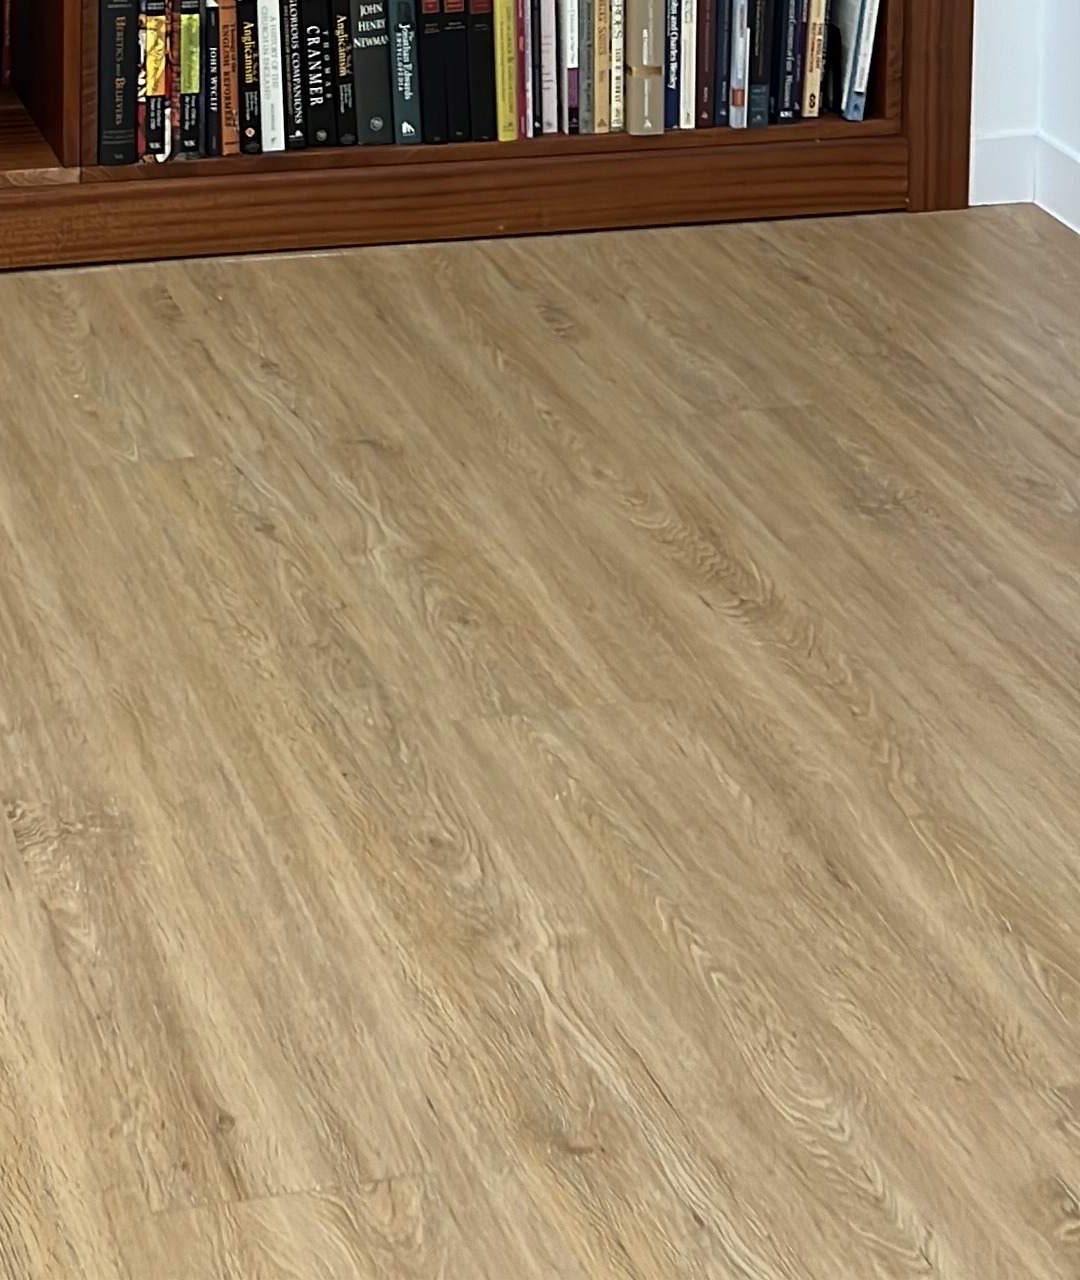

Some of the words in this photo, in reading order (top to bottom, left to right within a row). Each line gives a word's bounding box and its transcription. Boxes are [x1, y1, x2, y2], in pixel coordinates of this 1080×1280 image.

[358, 19, 386, 32] HENRY
[360, 3, 382, 16] JOHN
[669, 16, 677, 30] and
[209, 47, 217, 73] JOHN
[241, 22, 255, 83] Anglicanism
[334, 15, 347, 76] Anglicanism
[353, 36, 389, 48] NEWMAN
[397, 23, 412, 62] Jonathan
[669, 32, 678, 61] Charles
[306, 26, 323, 106] CRANMER
[322, 30, 332, 99] THOMAS
[403, 64, 413, 100] Edwards
[666, 62, 677, 90] Wesley
[210, 76, 218, 112] WYCLIF
[291, 52, 302, 124] COMPANIONS
